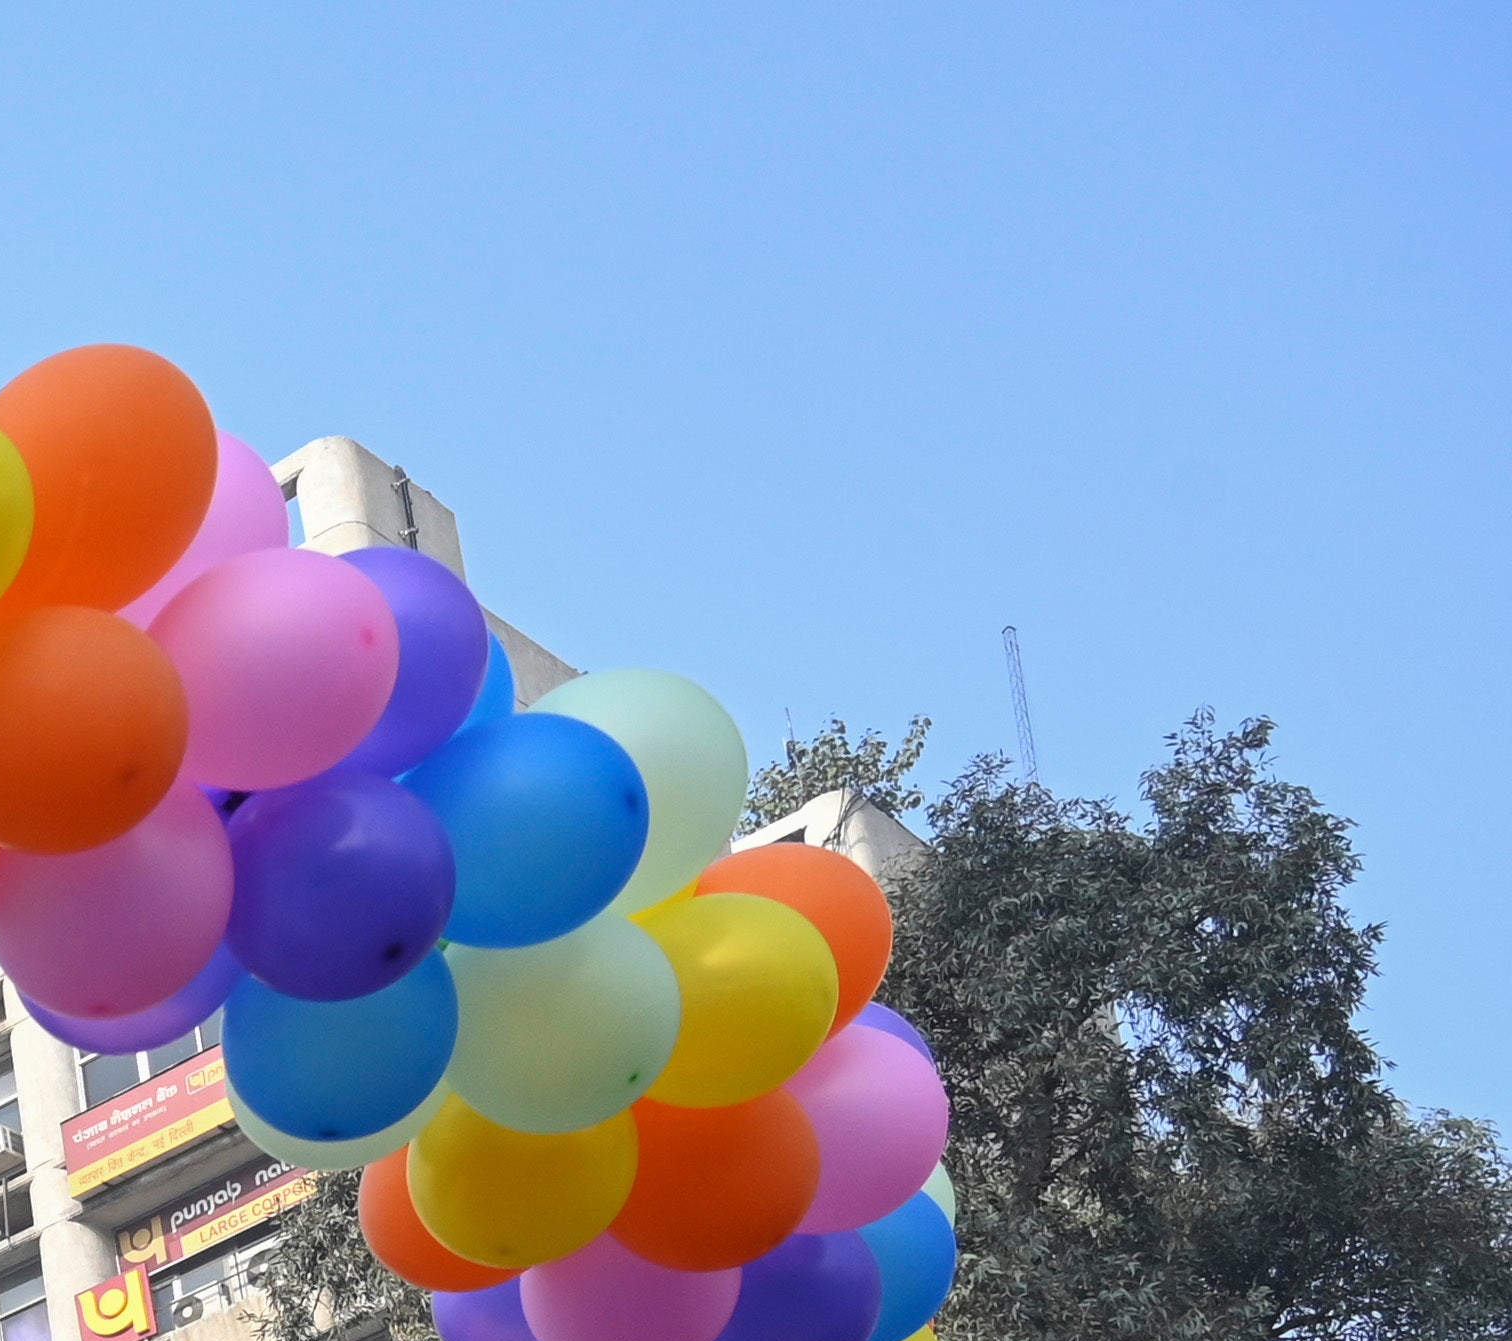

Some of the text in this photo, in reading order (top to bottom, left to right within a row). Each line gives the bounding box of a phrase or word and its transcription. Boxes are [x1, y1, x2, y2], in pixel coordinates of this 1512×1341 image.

[208, 1065, 223, 1082] pn
[72, 1119, 108, 1143] पंजाब
[168, 1119, 194, 1144] दिल्ली
[170, 1180, 242, 1234] punjab
[199, 1211, 249, 1244] LARGE
